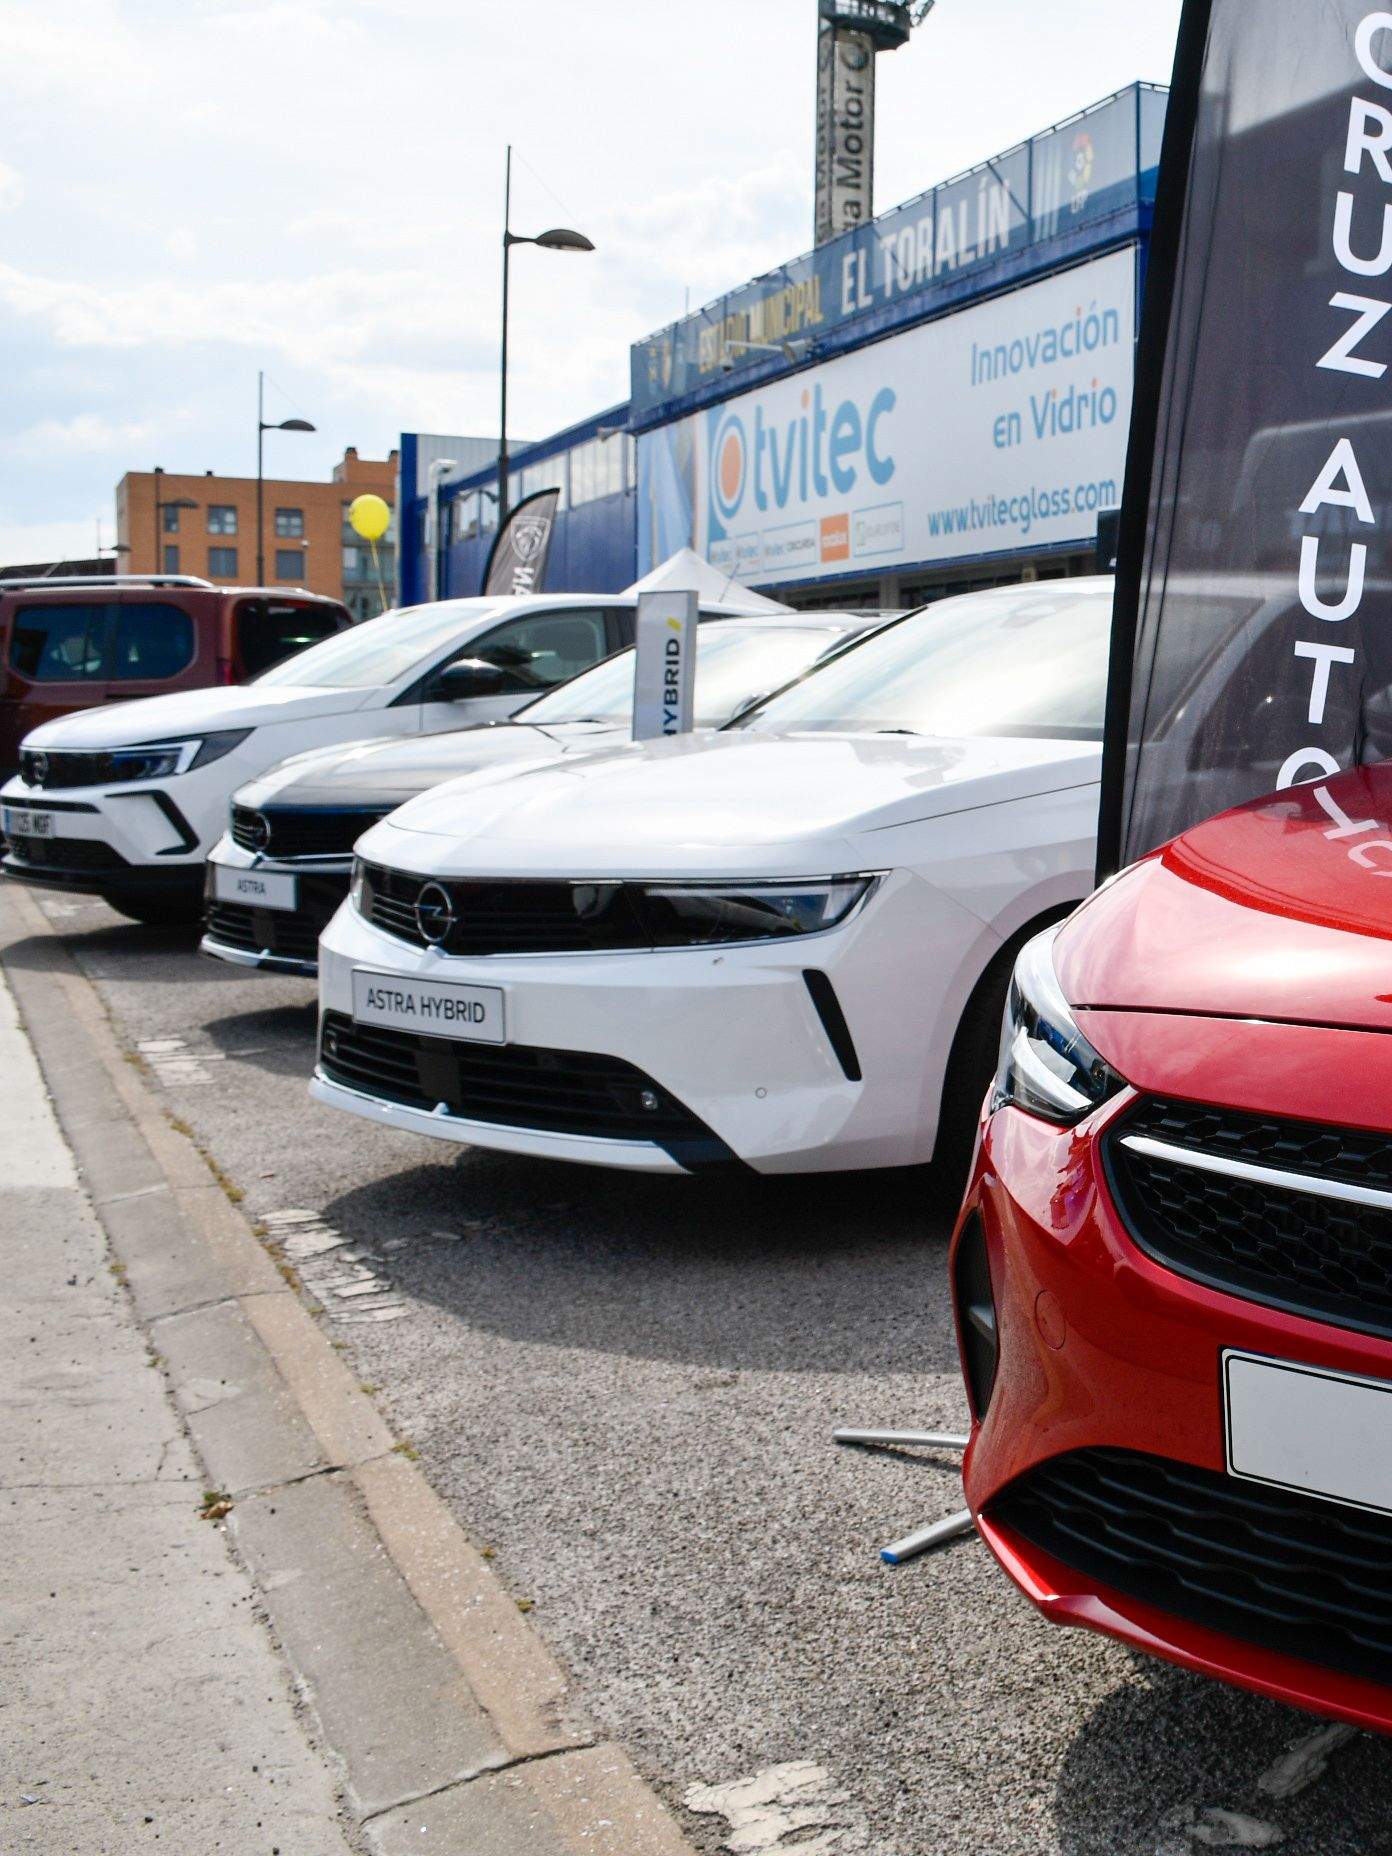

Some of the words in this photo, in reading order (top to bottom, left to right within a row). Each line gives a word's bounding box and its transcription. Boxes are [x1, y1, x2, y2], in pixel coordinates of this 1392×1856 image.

[836, 80, 864, 190] Motor
[841, 247, 873, 316] EL
[879, 176, 1010, 299] TORALÍN
[971, 300, 1119, 387] Innovación
[754, 382, 897, 512] tvitec
[993, 410, 1021, 449] en
[1029, 378, 1117, 440] Vidrio
[927, 478, 1116, 534] www.tvitecglass.com
[237, 878, 267, 895] ASTRA
[367, 987, 417, 1015] ASTRA
[420, 996, 486, 1024] HYBRID
